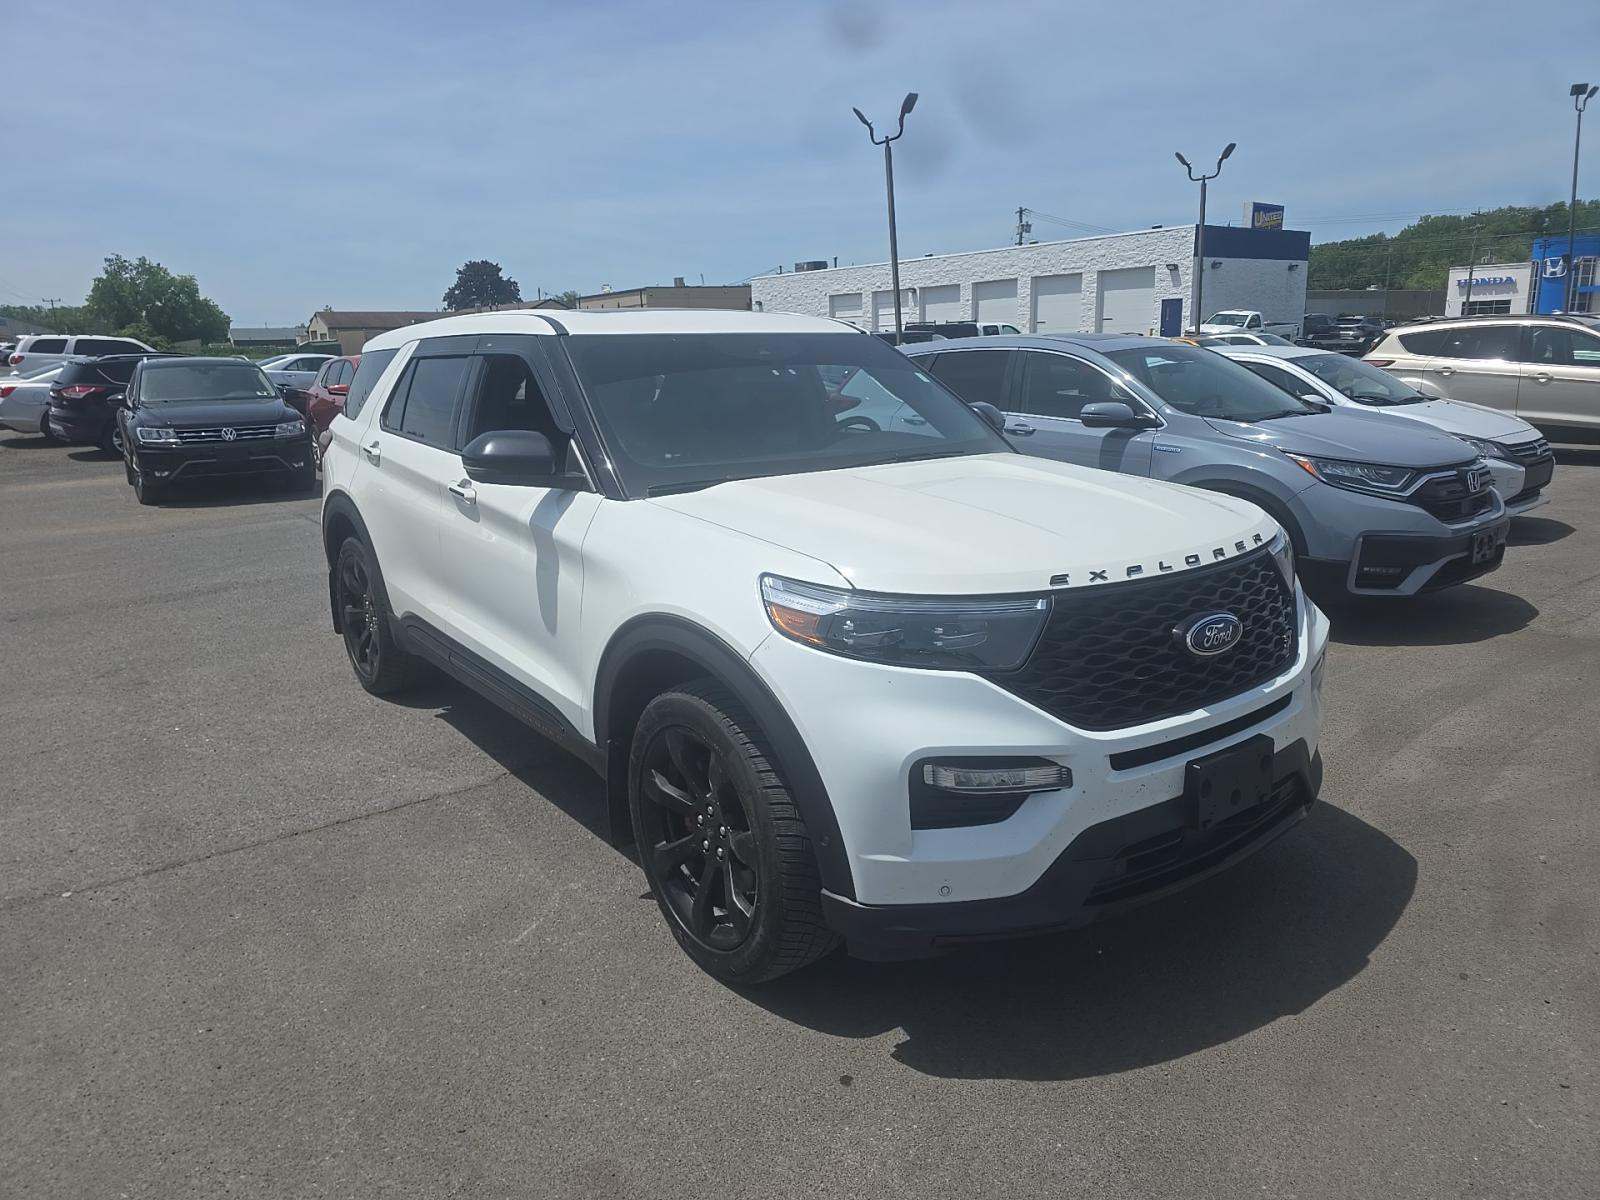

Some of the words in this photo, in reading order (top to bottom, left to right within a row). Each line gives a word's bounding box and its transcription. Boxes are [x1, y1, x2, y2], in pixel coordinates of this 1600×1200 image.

[1456, 276, 1517, 288] HONDA
[1049, 533, 1264, 586] EXPLORER
[1203, 622, 1233, 648] Ford
